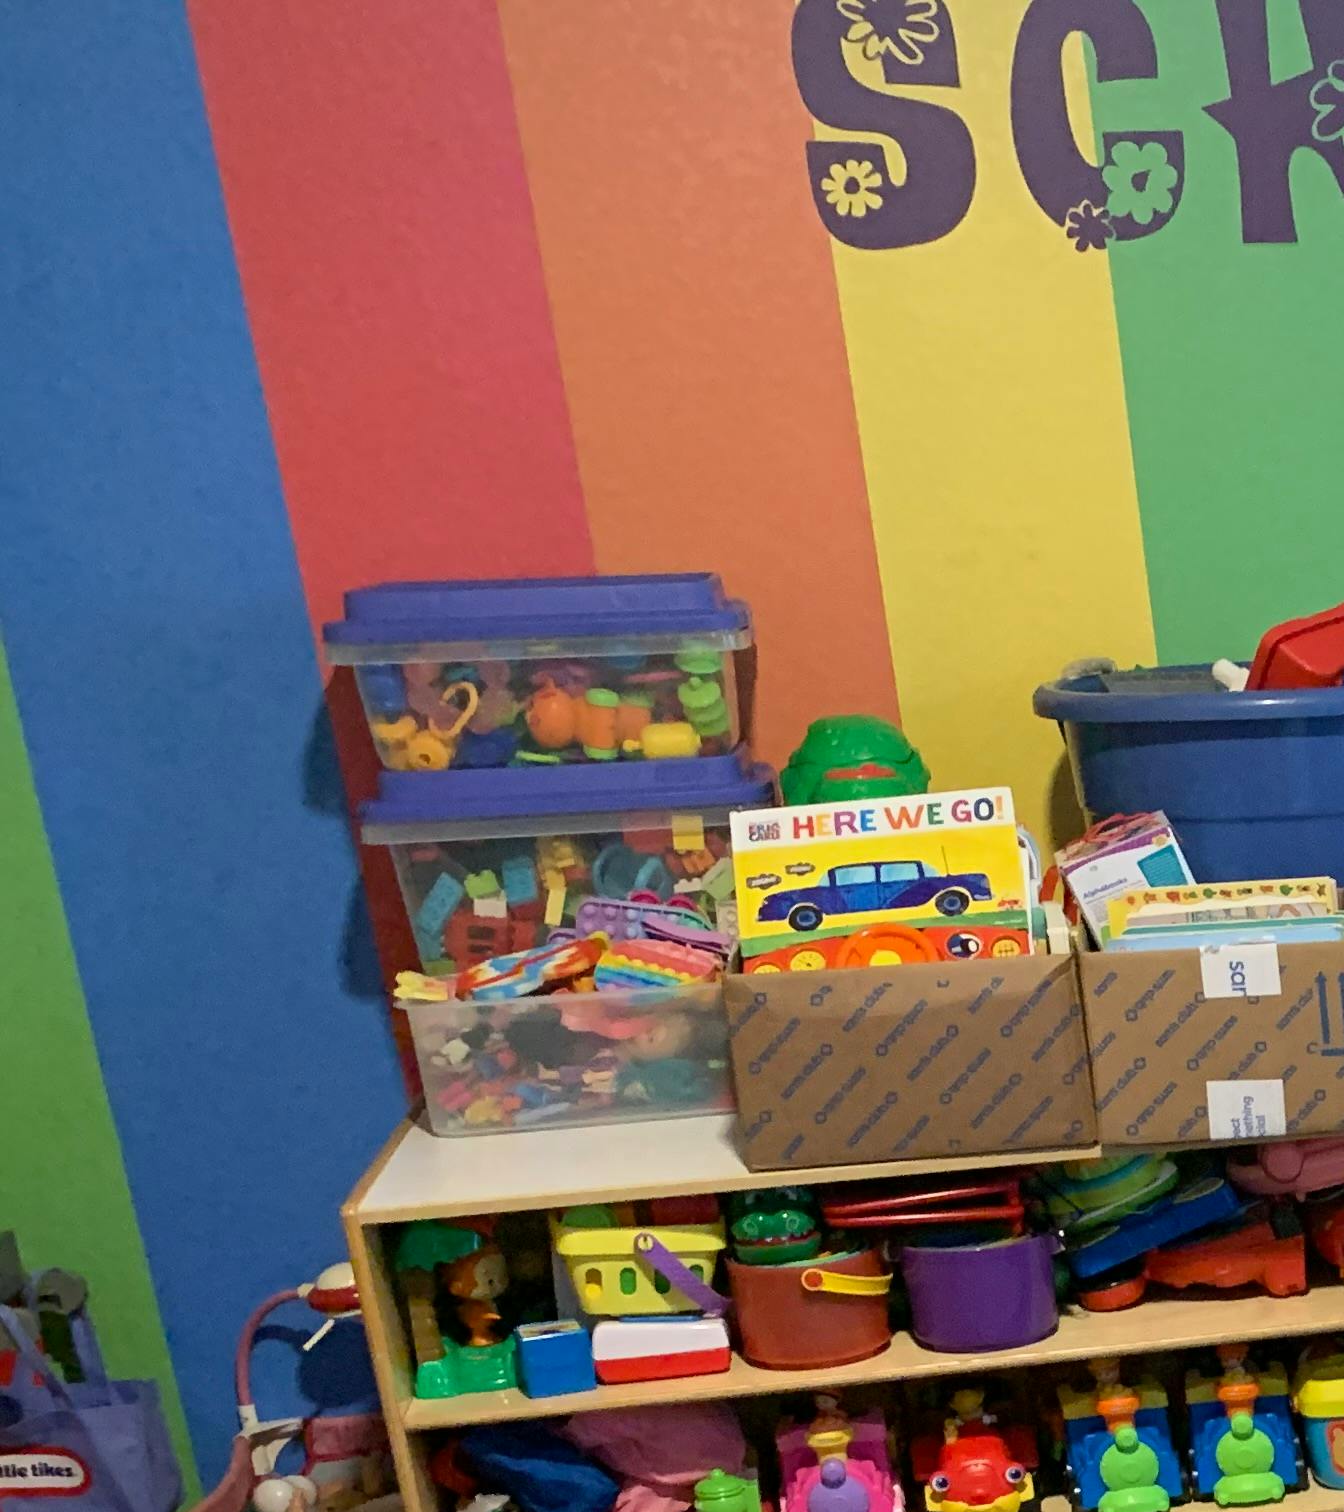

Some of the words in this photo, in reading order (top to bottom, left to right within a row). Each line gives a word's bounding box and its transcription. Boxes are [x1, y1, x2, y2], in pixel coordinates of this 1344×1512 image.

[792, 809, 877, 839] HERE
[884, 803, 944, 831] WE
[951, 796, 1004, 823] GO!
[31, 1461, 73, 1477] tikes
